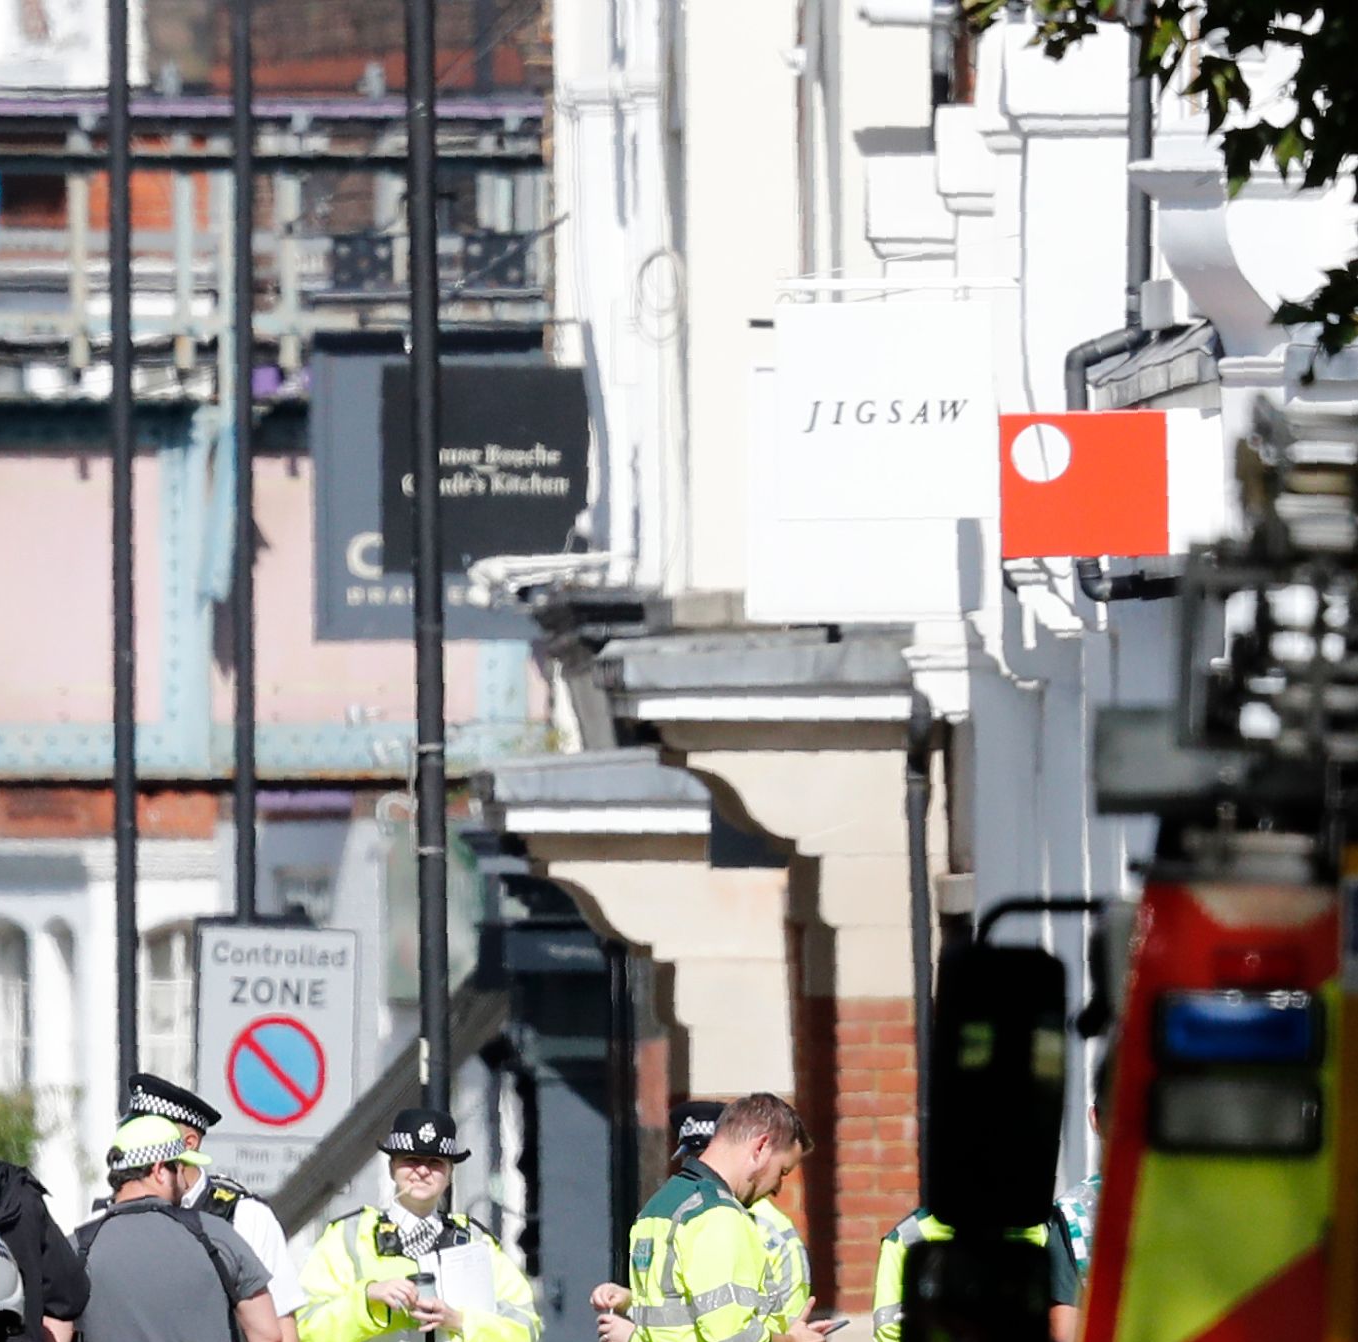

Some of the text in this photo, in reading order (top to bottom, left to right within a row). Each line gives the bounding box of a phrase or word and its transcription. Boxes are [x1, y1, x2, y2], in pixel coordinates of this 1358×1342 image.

[802, 398, 969, 433] JIGSAW
[490, 471, 571, 497] Kitchen
[211, 939, 348, 968] Controlled
[230, 976, 327, 1006] ZONE
